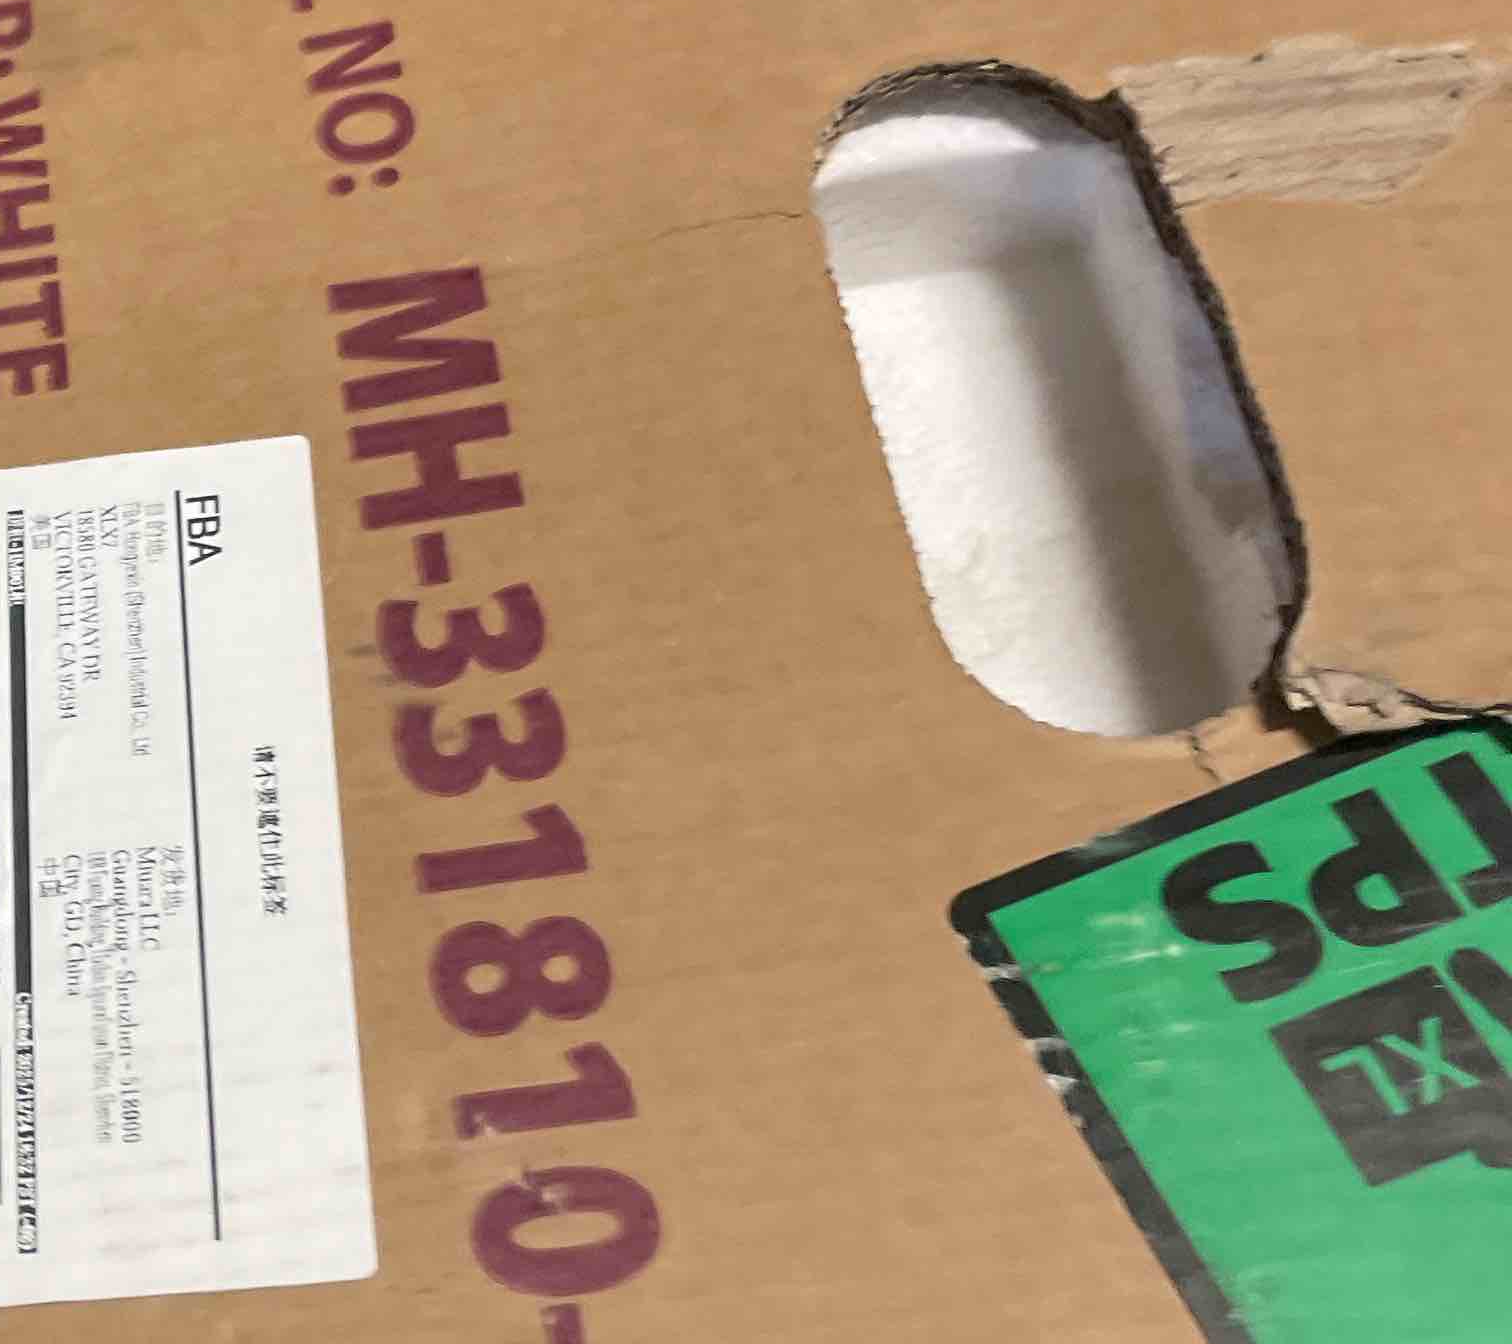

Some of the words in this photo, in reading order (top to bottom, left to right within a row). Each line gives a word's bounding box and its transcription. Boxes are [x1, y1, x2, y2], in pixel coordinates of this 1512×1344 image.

[300, 18, 416, 197] NO:
[185, 494, 222, 566] FBA
[79, 556, 98, 648] GATEWAY
[57, 642, 74, 668] CA
[82, 655, 100, 682] DR
[61, 855, 82, 895] City,
[111, 850, 133, 951] Guangdong
[61, 901, 83, 937] GD,
[137, 913, 158, 951] LLC
[64, 943, 84, 996] China
[117, 970, 136, 1056] Shenzhen
[1320, 1015, 1482, 1117] XL
[119, 1077, 140, 1144] 518000
